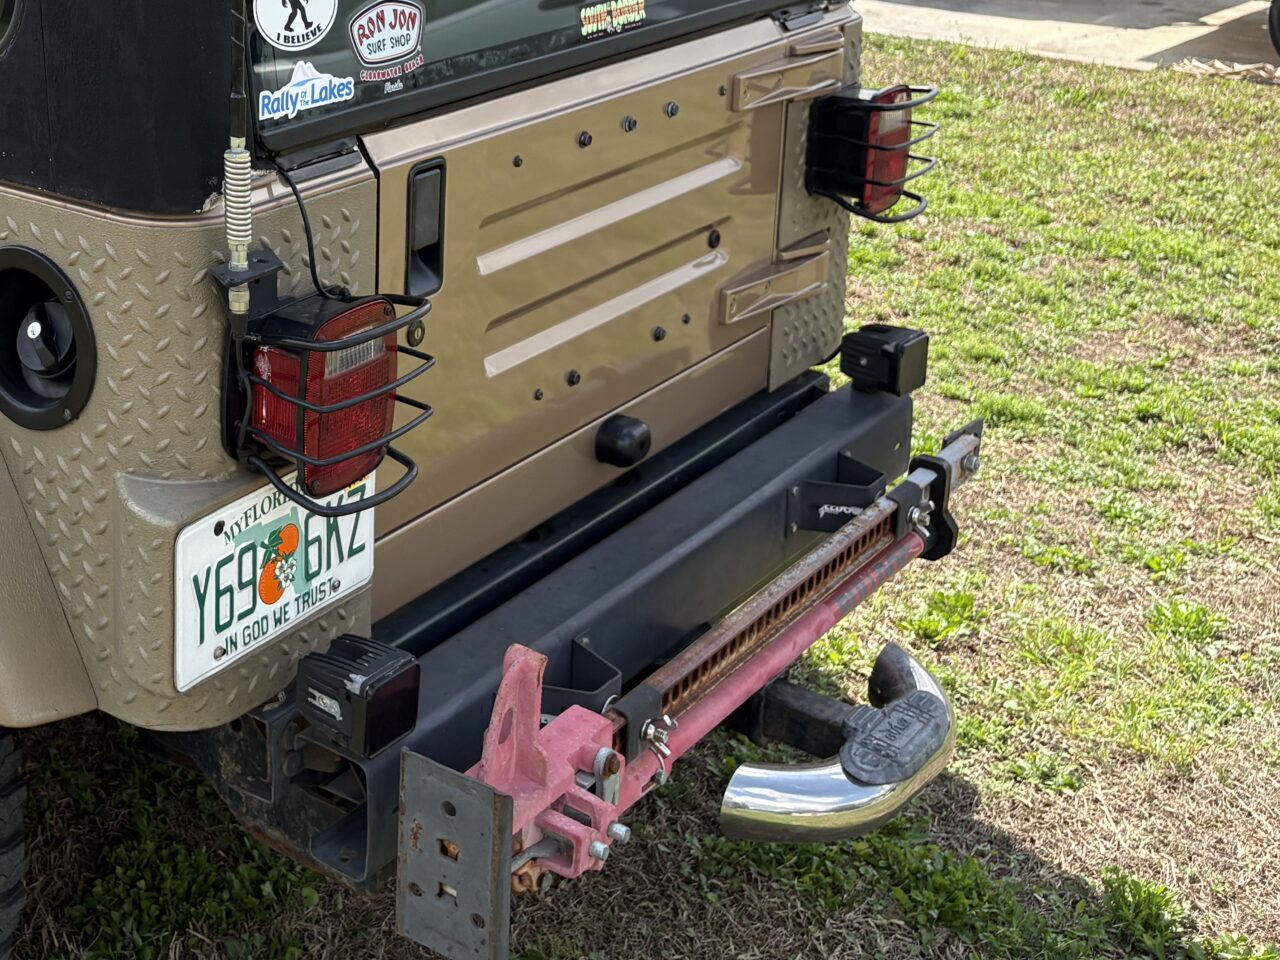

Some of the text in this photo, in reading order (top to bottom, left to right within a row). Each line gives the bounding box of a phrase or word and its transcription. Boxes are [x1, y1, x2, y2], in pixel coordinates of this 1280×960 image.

[283, 23, 323, 44] BELIEVE
[357, 9, 417, 46] RON JON
[366, 33, 411, 55] SURF SHOP
[261, 89, 299, 116] Rally
[311, 78, 353, 104] Lakes
[192, 541, 258, 645] Y69
[224, 576, 335, 656] IN GOD WE TRUST
